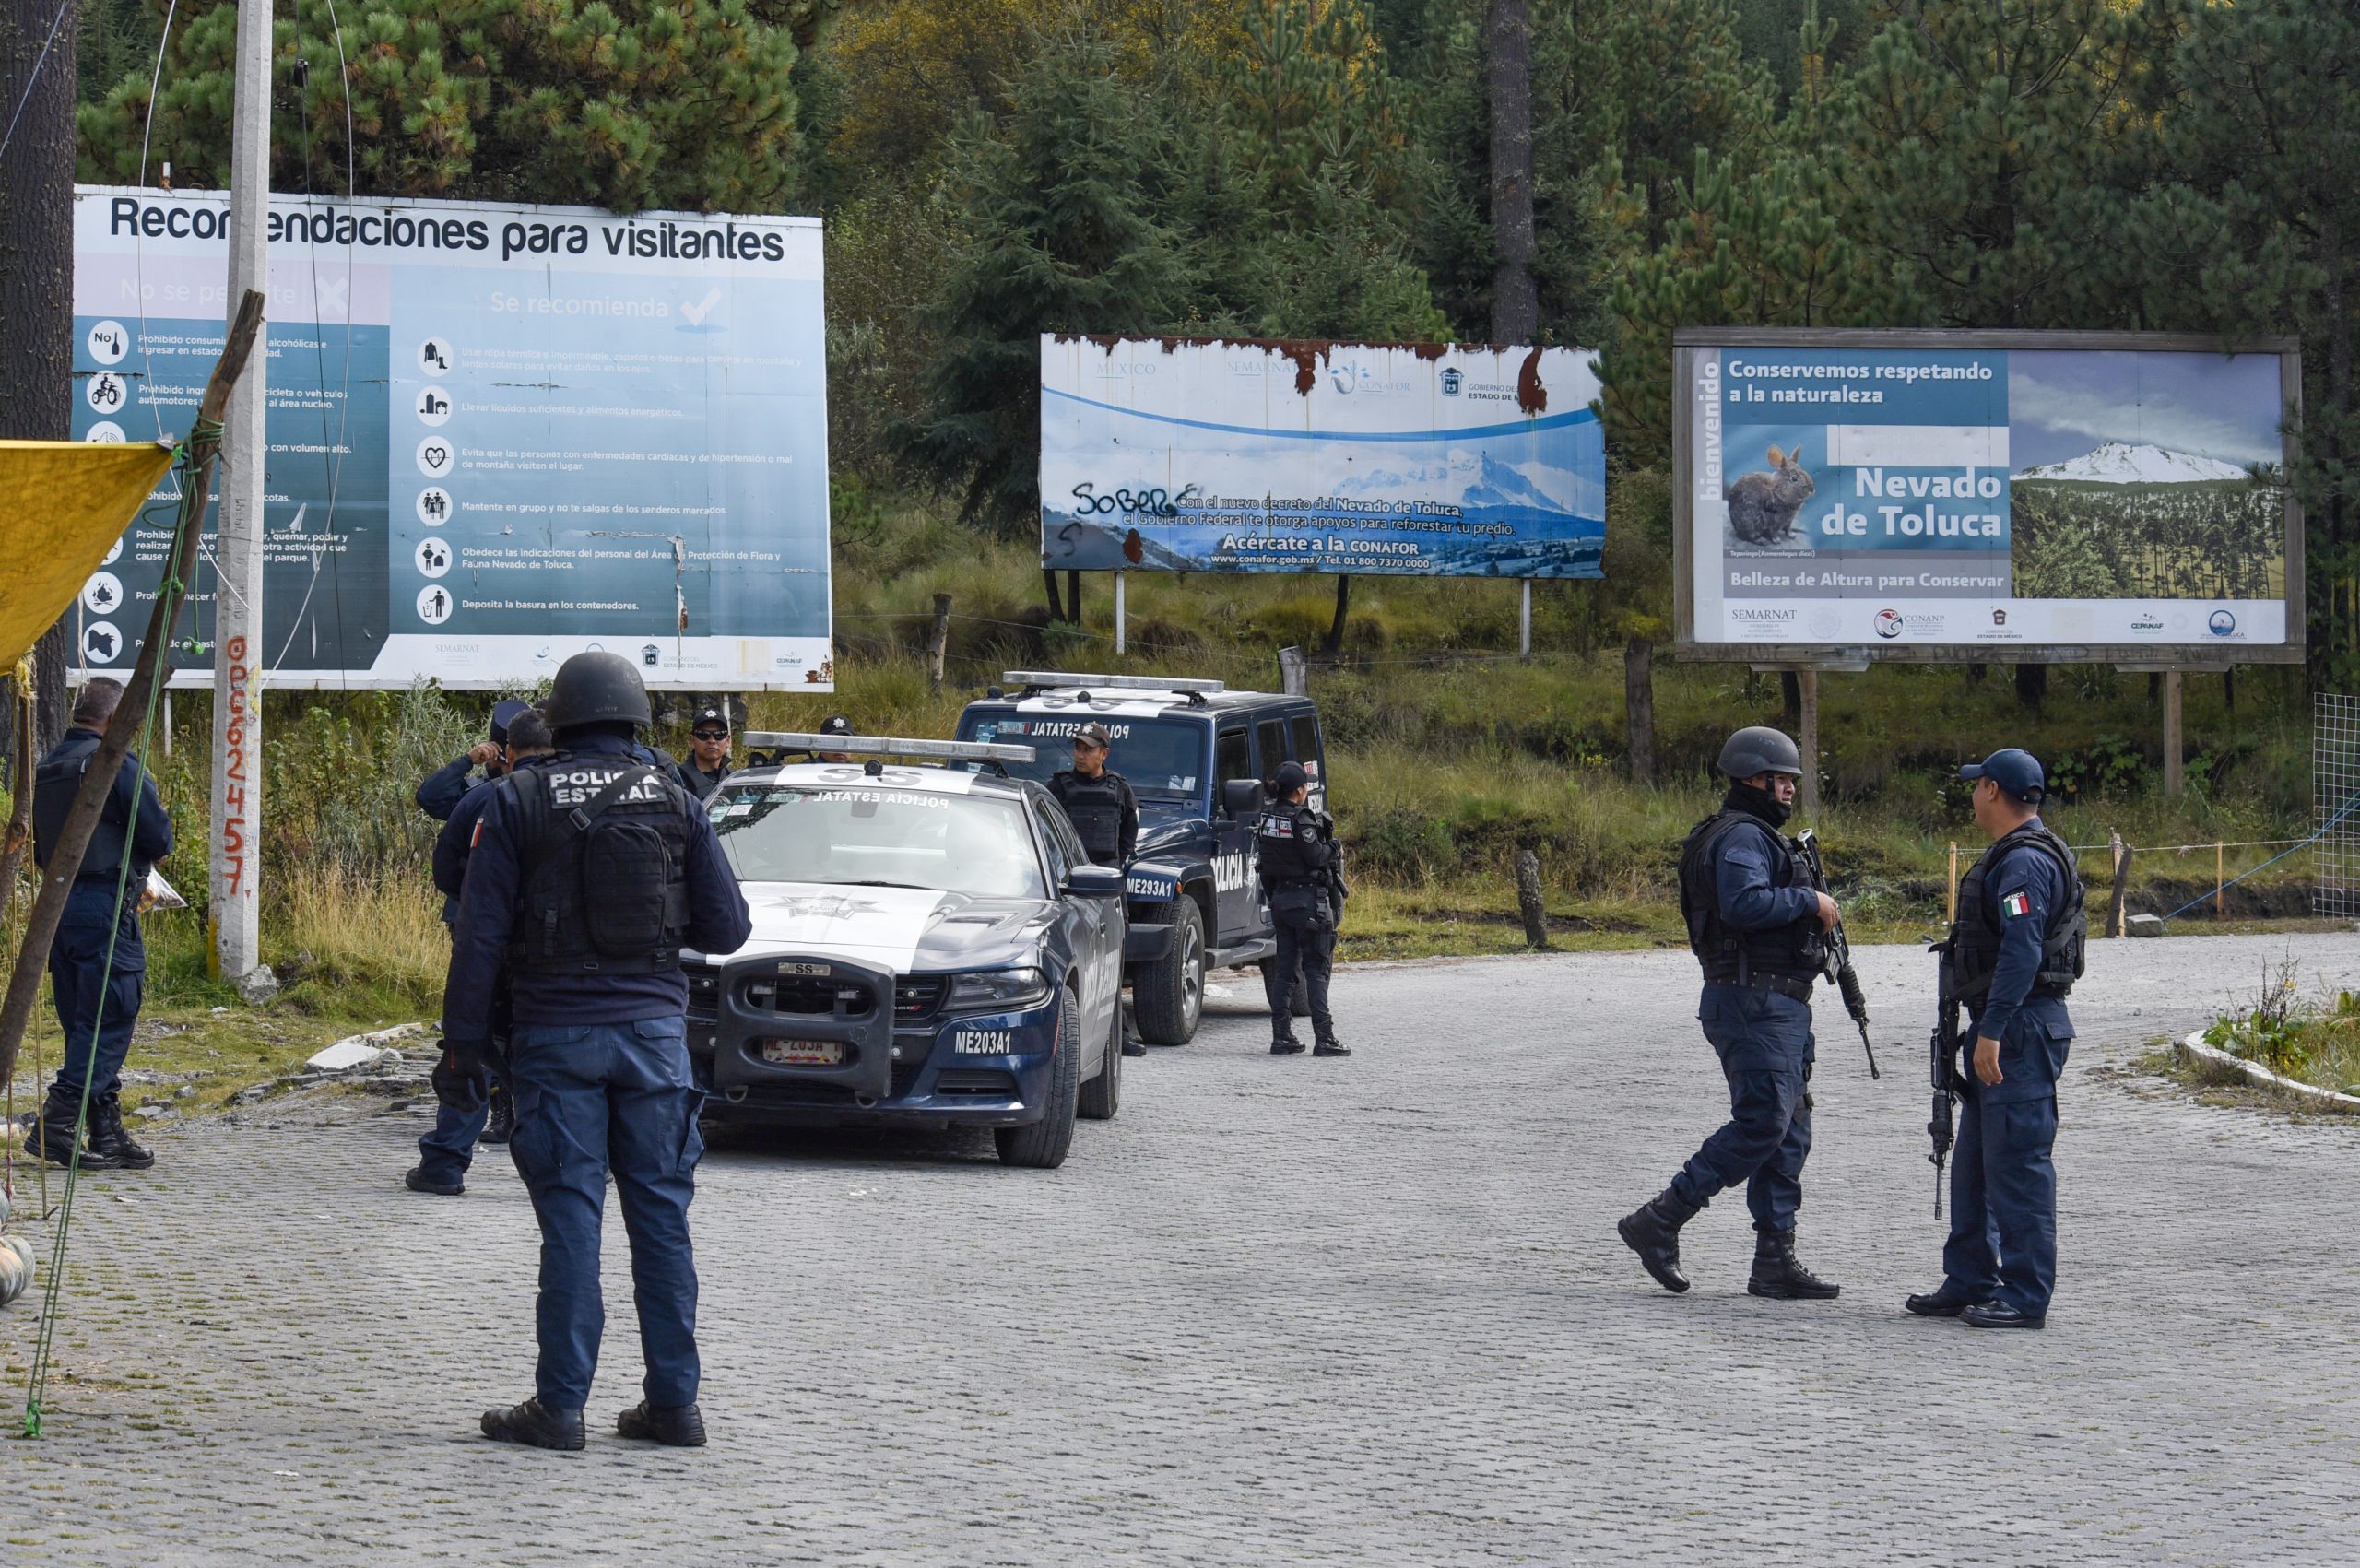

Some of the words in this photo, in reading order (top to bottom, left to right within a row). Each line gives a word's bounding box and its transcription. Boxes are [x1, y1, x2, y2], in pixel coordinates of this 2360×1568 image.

[111, 196, 489, 253] Recoendaciones
[502, 219, 588, 262] para
[602, 219, 785, 262] visitantes
[121, 279, 155, 301] No
[163, 283, 190, 301] se
[199, 282, 296, 306] peite
[491, 291, 520, 312] Se
[525, 295, 669, 319] recomienda
[94, 332, 112, 343] No
[138, 334, 183, 346] Prohibido
[268, 338, 319, 348] alcohólicas
[138, 345, 175, 356] ingresar
[192, 346, 223, 356] estado
[1729, 360, 1870, 379] Conservemos
[1875, 361, 1993, 384] respetando
[138, 384, 183, 395] Prohibido
[1469, 383, 1504, 393] GOBIERNO
[1729, 389, 1741, 403] a
[1747, 384, 1765, 403] la
[1772, 384, 1884, 404] naturaleza
[138, 395, 197, 406] automotores
[268, 399, 277, 407] al
[279, 398, 300, 408] área
[462, 403, 490, 412] Llevar
[491, 403, 526, 414] líquidos
[529, 404, 576, 414] suficientes
[585, 405, 629, 415] alimentos
[631, 407, 685, 419] energéticos.
[1698, 361, 1720, 501] bienvenido
[270, 444, 289, 453] con
[290, 443, 329, 453] volumen
[331, 444, 352, 454] alto.
[462, 448, 485, 457] Evita
[487, 451, 503, 460] que
[505, 449, 518, 458] las
[520, 451, 561, 460] personas
[582, 450, 645, 461] enfermedades
[698, 454, 709, 462] de
[712, 453, 766, 465] hipertensión
[776, 454, 793, 464] mal
[462, 460, 473, 468] de
[476, 460, 515, 469] montaña
[517, 461, 547, 470] visiten
[549, 461, 558, 470] el
[560, 461, 584, 472] lugar.
[1855, 466, 2002, 499] Nevado
[462, 501, 503, 512] Mantente
[505, 504, 516, 513] en
[519, 503, 546, 514] grupo
[557, 504, 568, 513] no
[570, 503, 579, 513] te
[582, 503, 609, 515] salgas
[612, 503, 623, 513] de
[626, 504, 639, 514] los
[641, 505, 680, 515] senderos
[1177, 495, 1204, 509] Con
[1206, 495, 1217, 509] el
[1219, 498, 1258, 510] nuevo
[1262, 497, 1312, 511] decreto
[1314, 497, 1333, 511] del
[1336, 499, 1390, 513] Nevado
[1394, 499, 1411, 514] de
[1414, 501, 1464, 518] Toluca,
[1123, 513, 1134, 525] el
[1137, 513, 1197, 526] Gobierno
[1199, 513, 1245, 525] Federal
[1249, 514, 1263, 526] te
[1266, 514, 1308, 529] otorga
[1311, 516, 1356, 531] apoyos
[1359, 518, 1388, 531] para
[1391, 516, 1453, 534] reforestar
[1457, 521, 1470, 534] tu
[1473, 522, 1516, 536] predio.
[1821, 503, 1868, 536] de
[1878, 504, 2002, 537] Toluca
[273, 534, 311, 542] quemar,
[313, 533, 340, 542] podar
[1222, 531, 1308, 552] Acércate
[1312, 538, 1324, 552] a
[1328, 536, 1346, 553] la
[1350, 539, 1420, 556] CONAFOR
[136, 541, 171, 550] realizar
[263, 543, 282, 551] otra
[284, 543, 326, 551] actividad
[275, 554, 310, 563] parque.
[462, 547, 502, 557] Obedece
[505, 548, 517, 558] las
[519, 548, 576, 558] indicaciones
[578, 548, 592, 559] del
[595, 549, 631, 560] personal
[634, 549, 648, 560] del
[650, 548, 672, 560] Área
[688, 549, 734, 560] Protección
[737, 551, 749, 560] de
[750, 551, 773, 561] Flora
[462, 560, 490, 570] Fauna
[491, 560, 526, 570] Nevado
[529, 560, 541, 570] de
[543, 560, 575, 571] Toluca.
[1325, 555, 1342, 566] Tel.
[1343, 556, 1357, 566] 01
[1358, 557, 1377, 567] 800
[1378, 558, 1404, 568] 7370
[1405, 559, 1430, 569] 0000
[1730, 572, 1791, 587] Belleza
[1795, 572, 1816, 587] de
[1820, 572, 1874, 588] Altura
[1878, 575, 1915, 591] para
[1919, 572, 2004, 588] Conservar
[462, 600, 502, 611] Deposita
[505, 600, 513, 609] la
[515, 600, 546, 610] basura
[549, 602, 560, 610] en
[561, 600, 574, 610] los
[576, 601, 640, 611] contenedores.
[1732, 609, 1798, 620] SEMARNAT
[435, 644, 480, 654] SEMARNAT
[1210, 848, 1243, 893] POLICÍA
[1126, 878, 1172, 897] ME293A1
[796, 964, 813, 974] SS
[954, 1032, 1010, 1055] ME203A1
